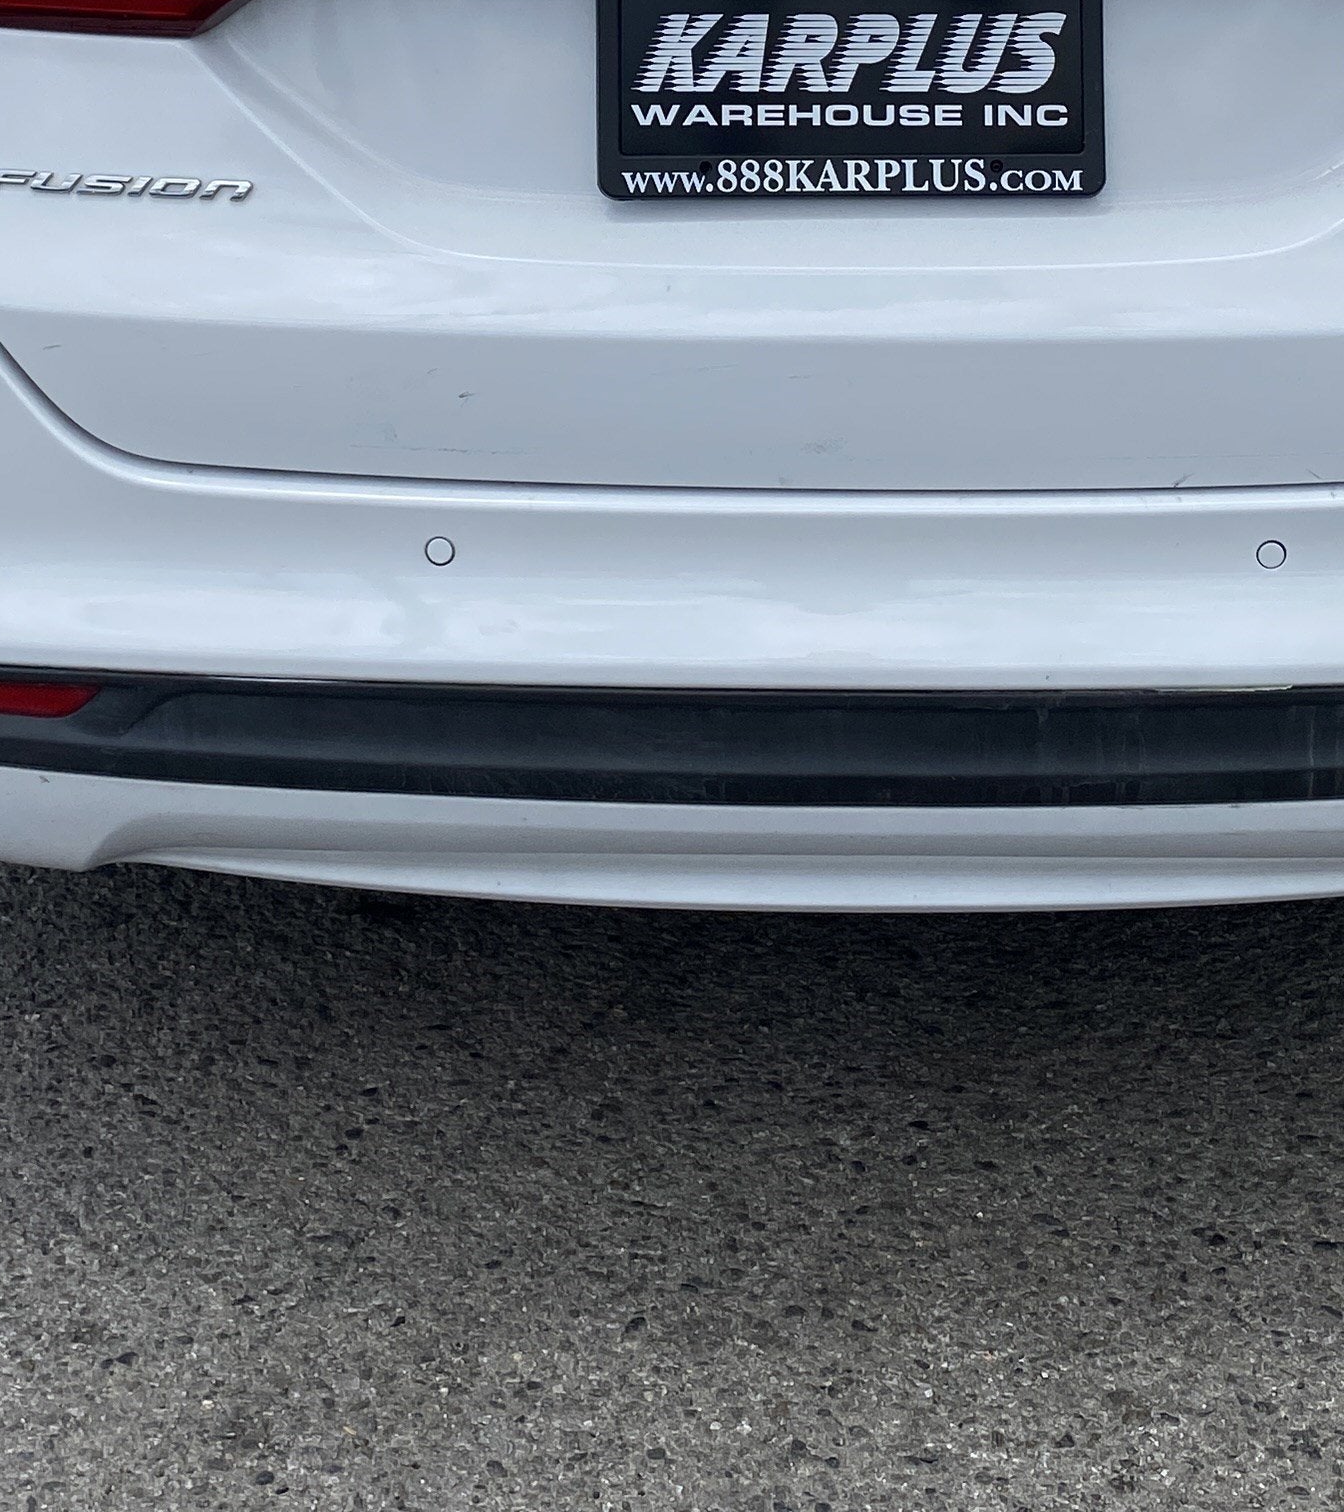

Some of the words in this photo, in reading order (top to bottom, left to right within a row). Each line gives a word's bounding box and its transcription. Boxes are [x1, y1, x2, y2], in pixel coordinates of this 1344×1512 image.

[631, 13, 1067, 94] KARPLUS
[631, 104, 963, 127] WAREHOUSE
[985, 104, 1069, 127] INC
